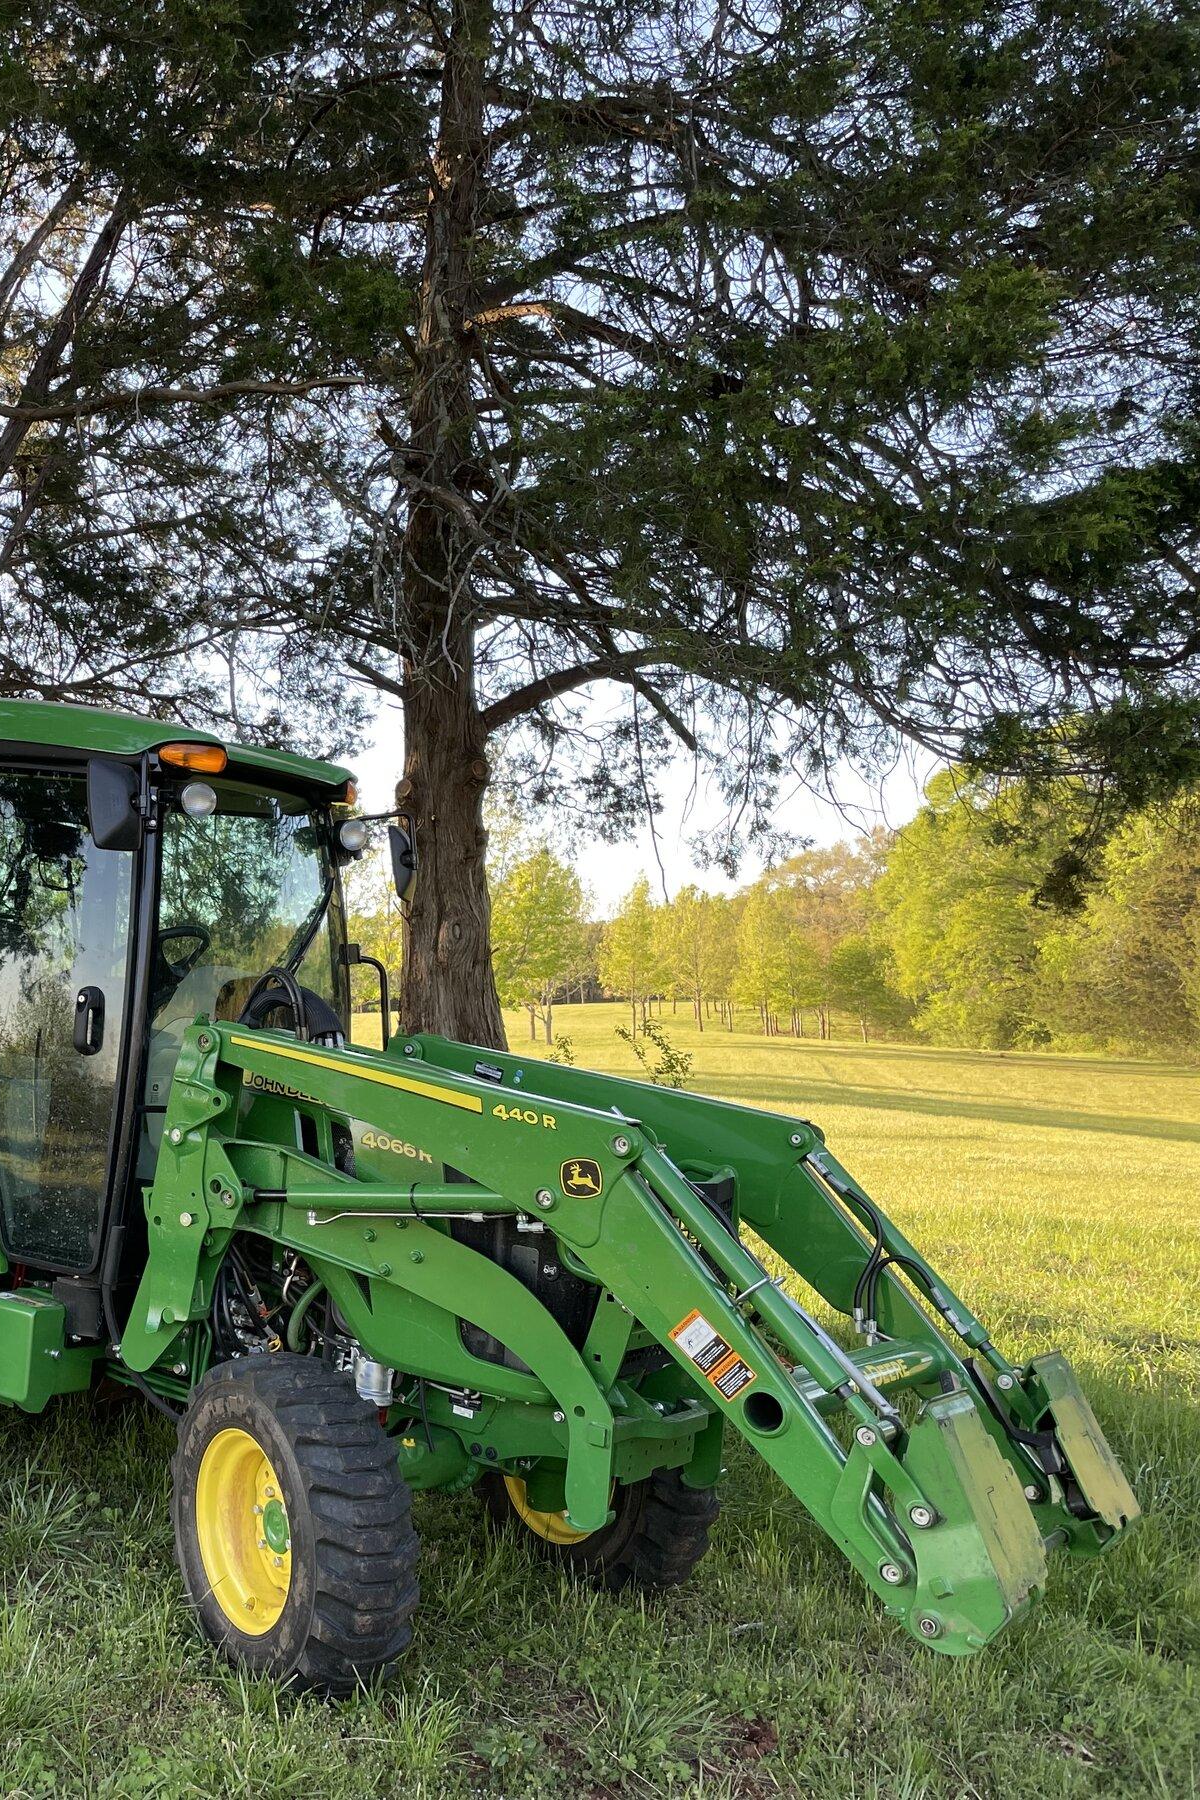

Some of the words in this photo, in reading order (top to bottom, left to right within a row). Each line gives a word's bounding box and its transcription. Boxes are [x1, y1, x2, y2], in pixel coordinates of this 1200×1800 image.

[244, 1071, 285, 1093] JOHN
[493, 1105, 538, 1127] 440
[542, 1119, 558, 1134] R
[360, 1131, 417, 1158] 4066
[865, 1358, 910, 1387] DEERE
